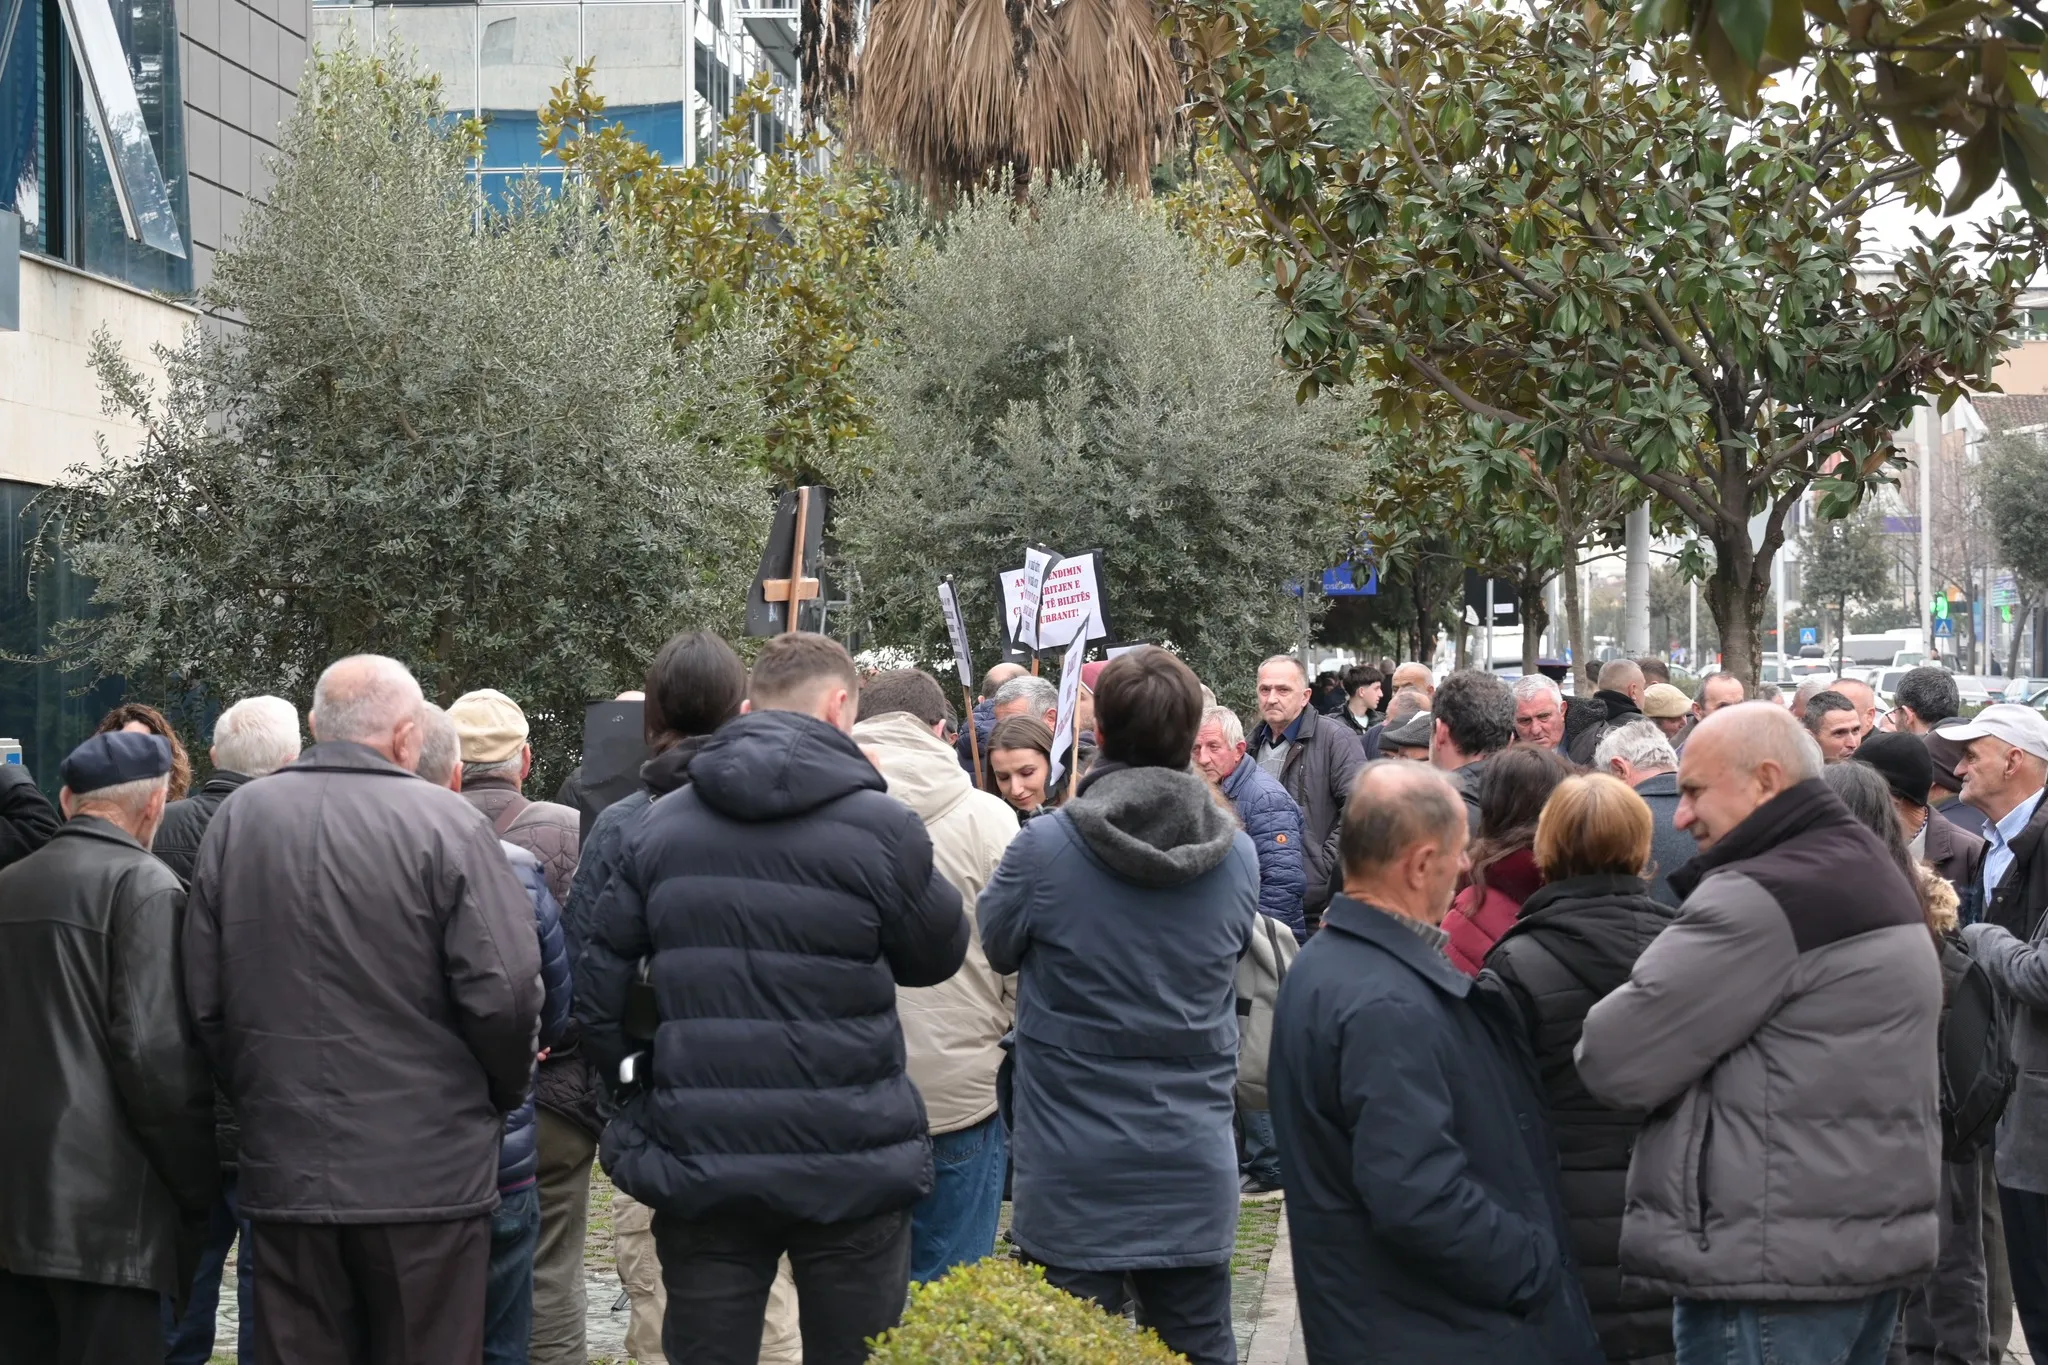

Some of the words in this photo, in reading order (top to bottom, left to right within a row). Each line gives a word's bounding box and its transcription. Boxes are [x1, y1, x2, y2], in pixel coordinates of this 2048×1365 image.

[1047, 565, 1082, 581] ENDIMIN
[1042, 581, 1073, 596] RITJEN
[1075, 579, 1081, 589] E
[1040, 608, 1079, 624] URBANIT!
